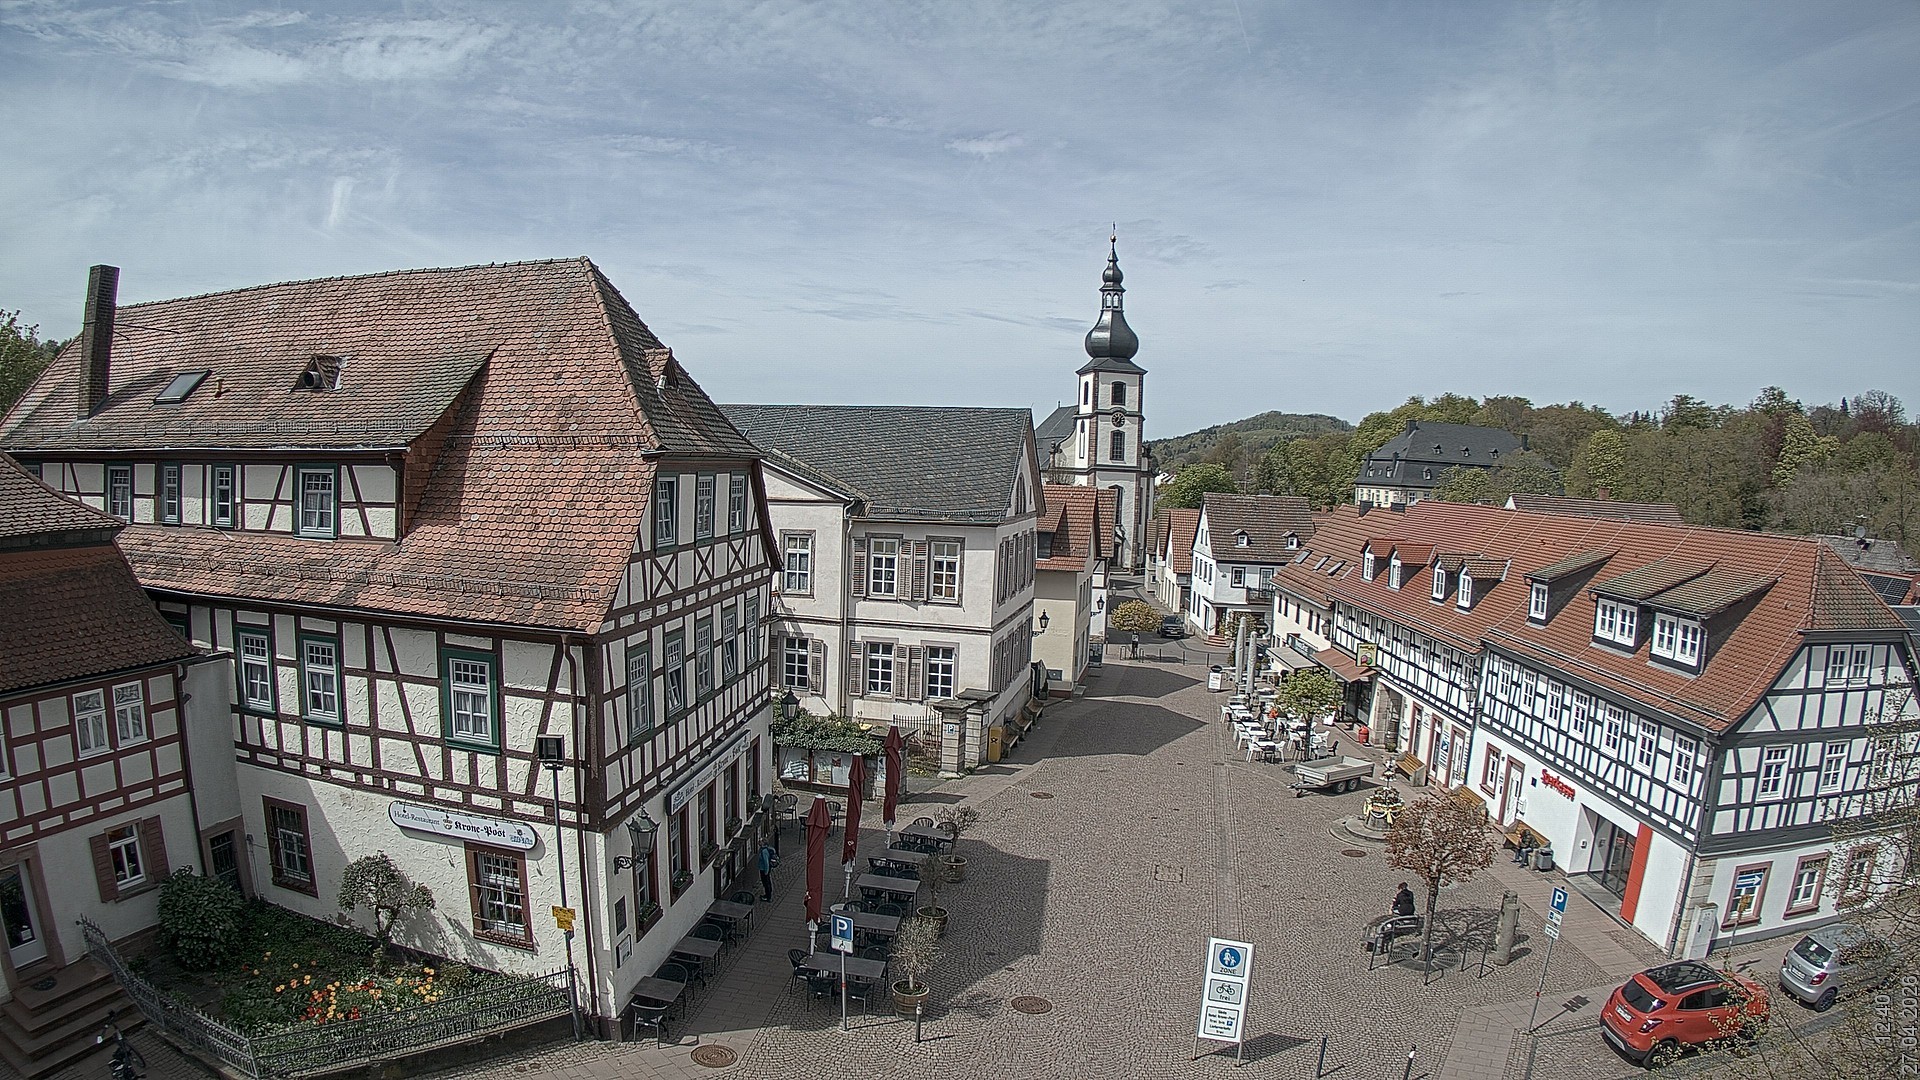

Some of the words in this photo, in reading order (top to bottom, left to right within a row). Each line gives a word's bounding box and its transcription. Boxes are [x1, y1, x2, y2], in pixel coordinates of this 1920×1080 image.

[454, 820, 506, 838] Krone-Post
[1553, 890, 1564, 907] P
[836, 918, 848, 935] P
[1219, 966, 1237, 974] ZONE
